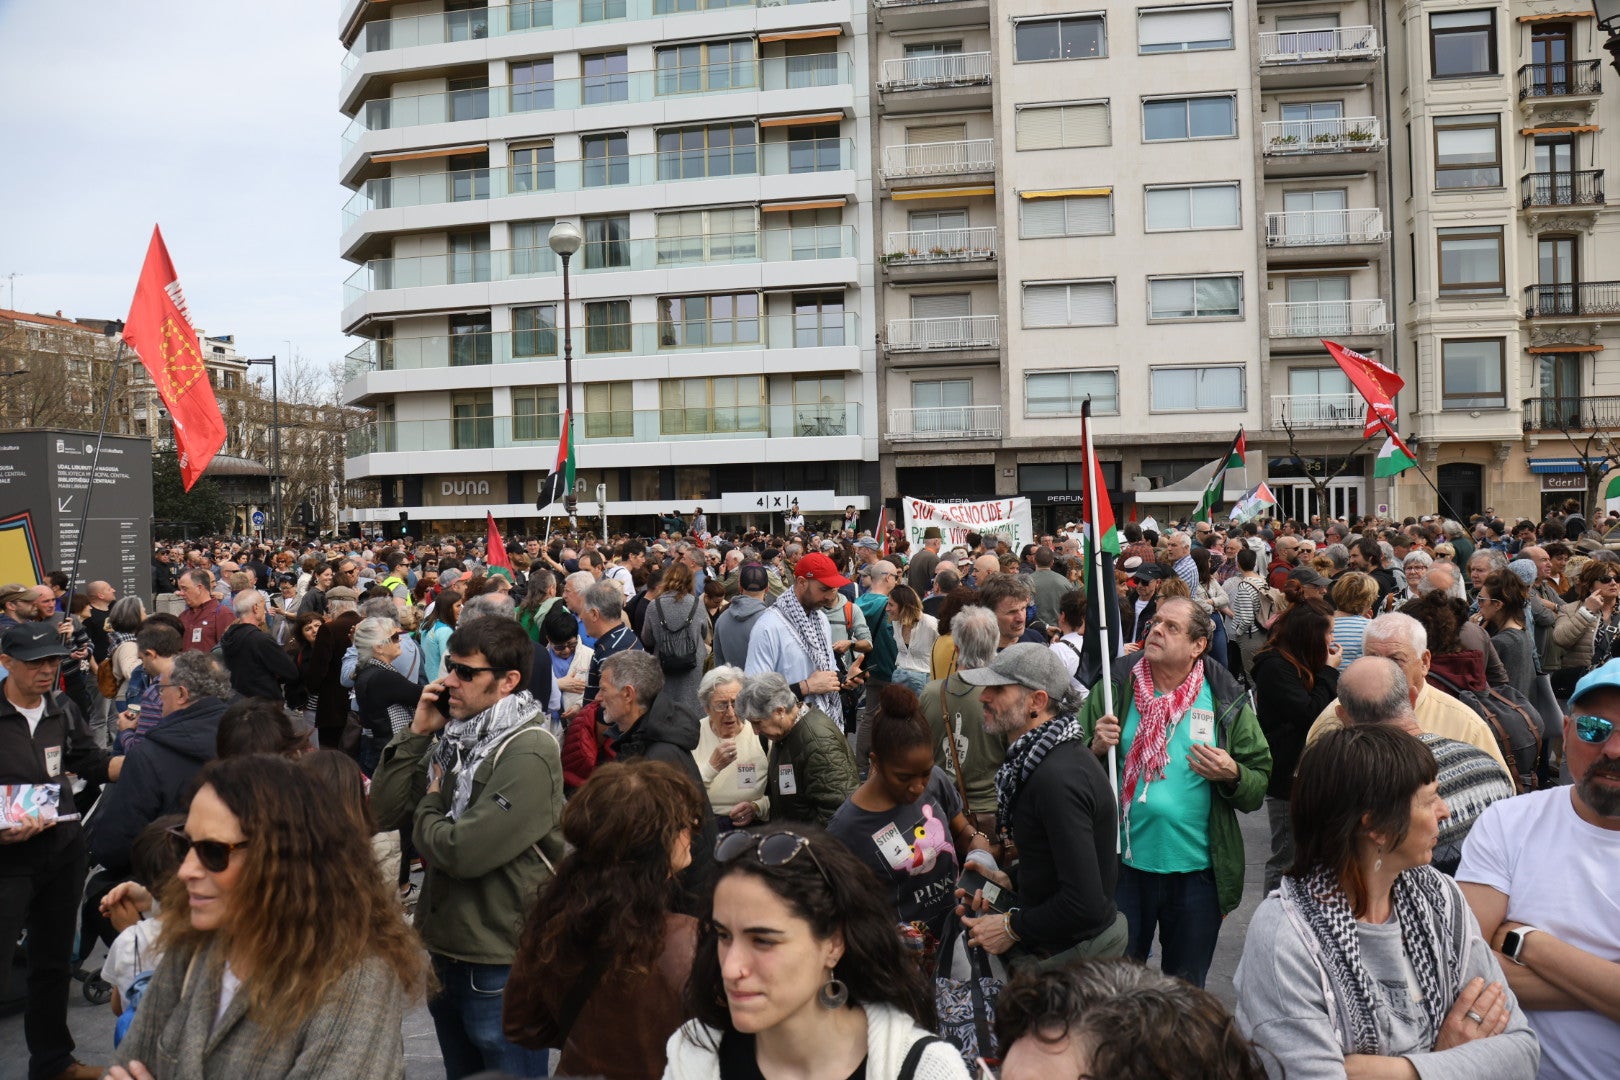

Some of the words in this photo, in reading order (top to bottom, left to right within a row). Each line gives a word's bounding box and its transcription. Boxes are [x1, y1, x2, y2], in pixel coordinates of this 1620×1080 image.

[441, 480, 489, 496] DUNA
[537, 477, 587, 493] DA
[1191, 712, 1213, 722] STOP!
[876, 827, 899, 846] STOP!
